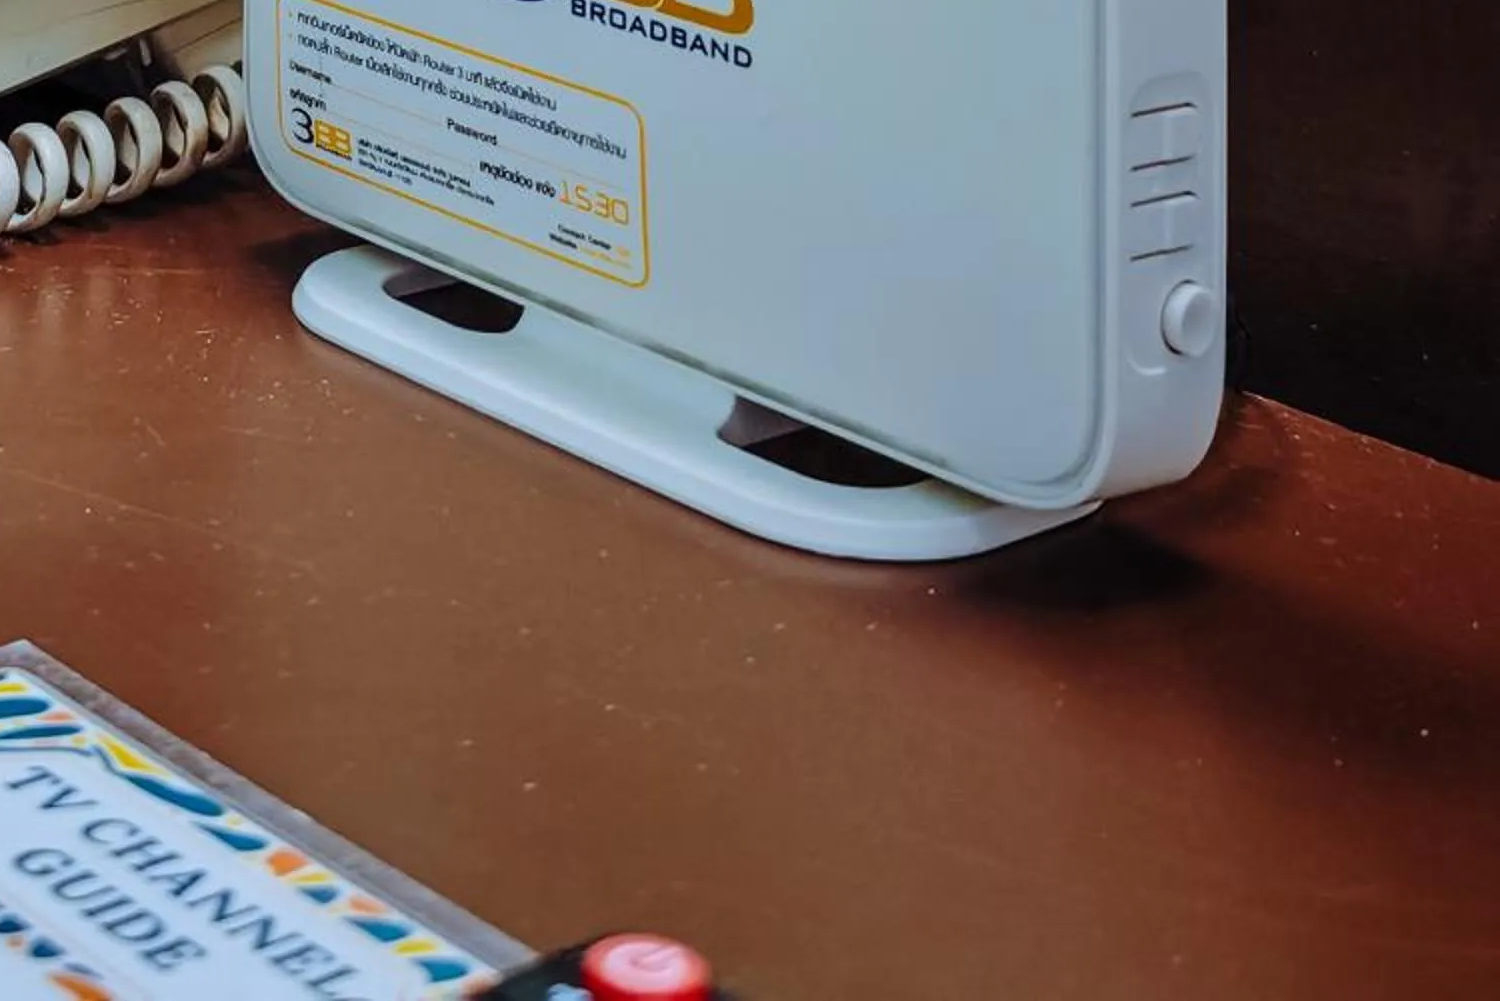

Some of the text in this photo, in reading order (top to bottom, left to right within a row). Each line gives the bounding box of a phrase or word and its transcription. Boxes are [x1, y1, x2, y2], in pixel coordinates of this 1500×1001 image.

[558, 180, 630, 226] 1530
[4, 764, 373, 1001] TV CHANNEL
[13, 847, 208, 971] GUIDE
